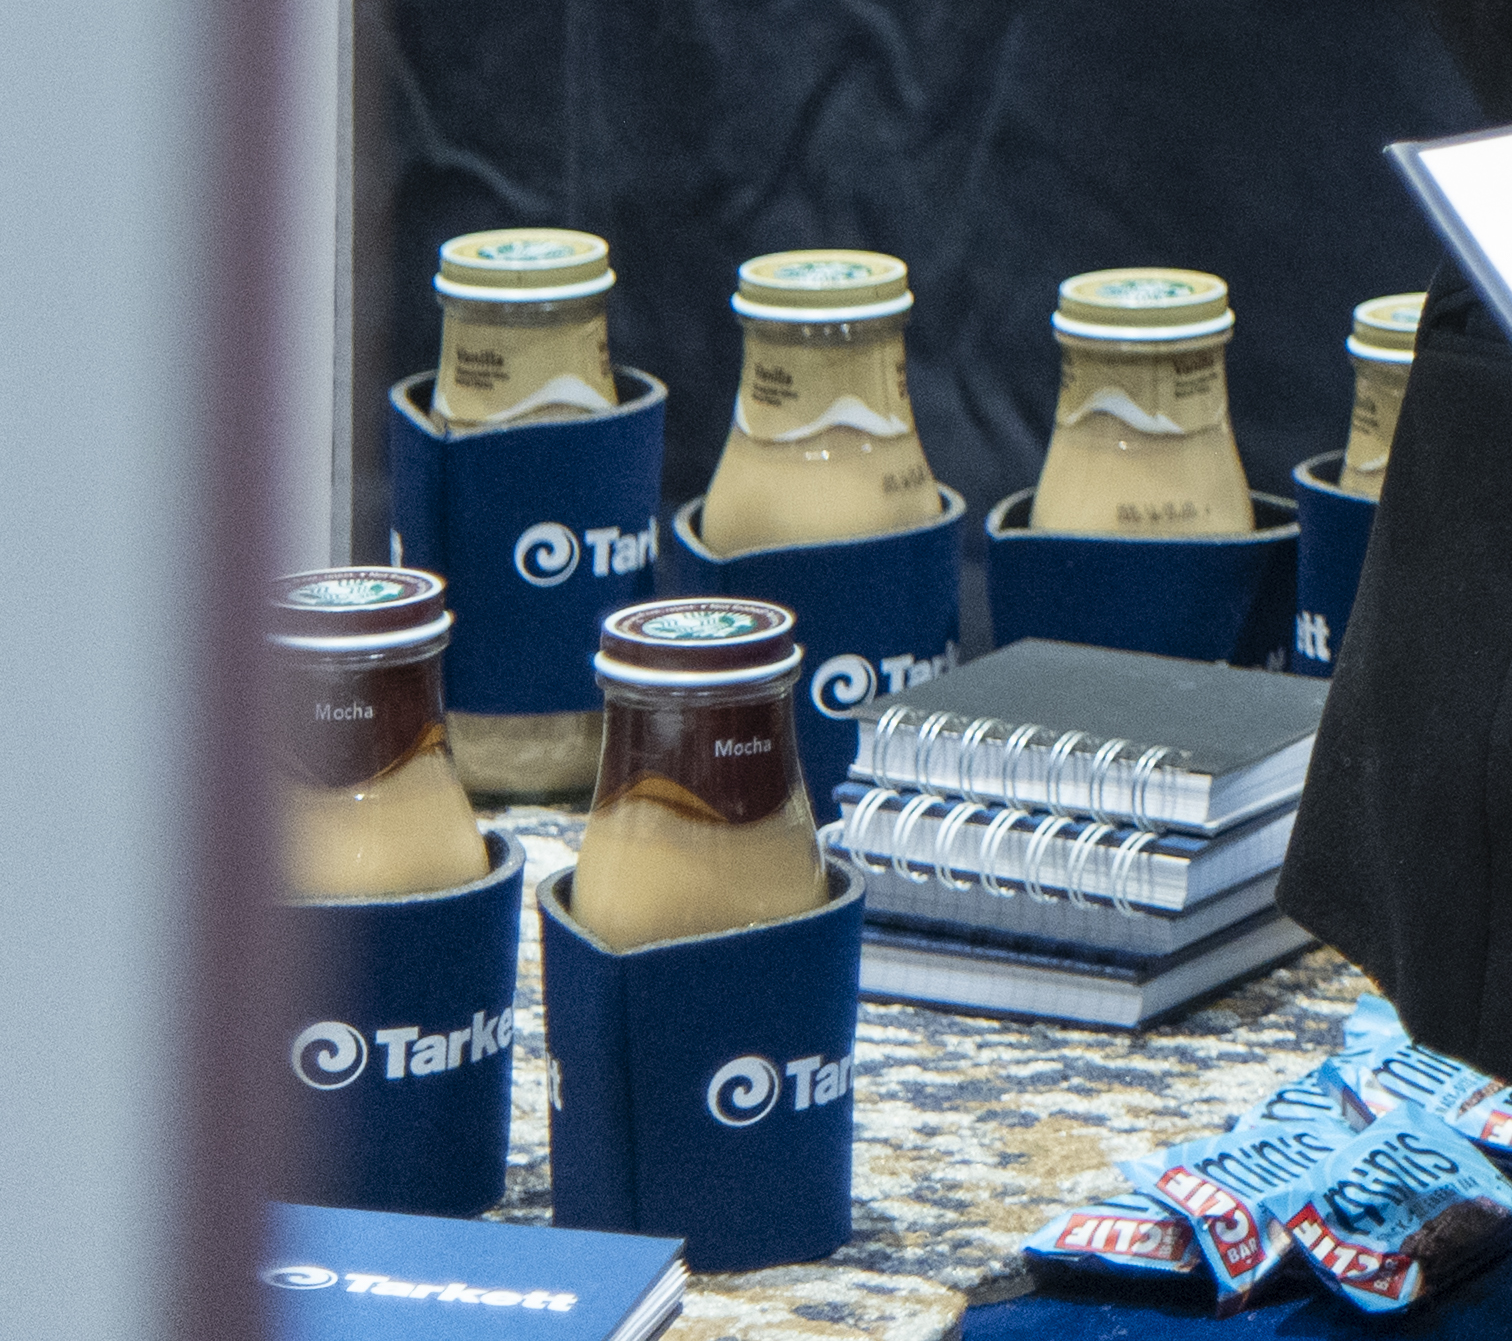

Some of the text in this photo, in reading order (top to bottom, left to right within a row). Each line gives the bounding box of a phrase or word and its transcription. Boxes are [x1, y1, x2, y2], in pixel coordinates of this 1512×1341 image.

[315, 700, 374, 721] Mocha
[714, 735, 772, 758] Mocha
[1165, 1170, 1250, 1244] CLIF
[1064, 1217, 1163, 1255] CLIF
[1227, 1237, 1259, 1265] BAR
[1293, 1219, 1380, 1280] CLIF
[344, 1272, 579, 1312] Tarkett
